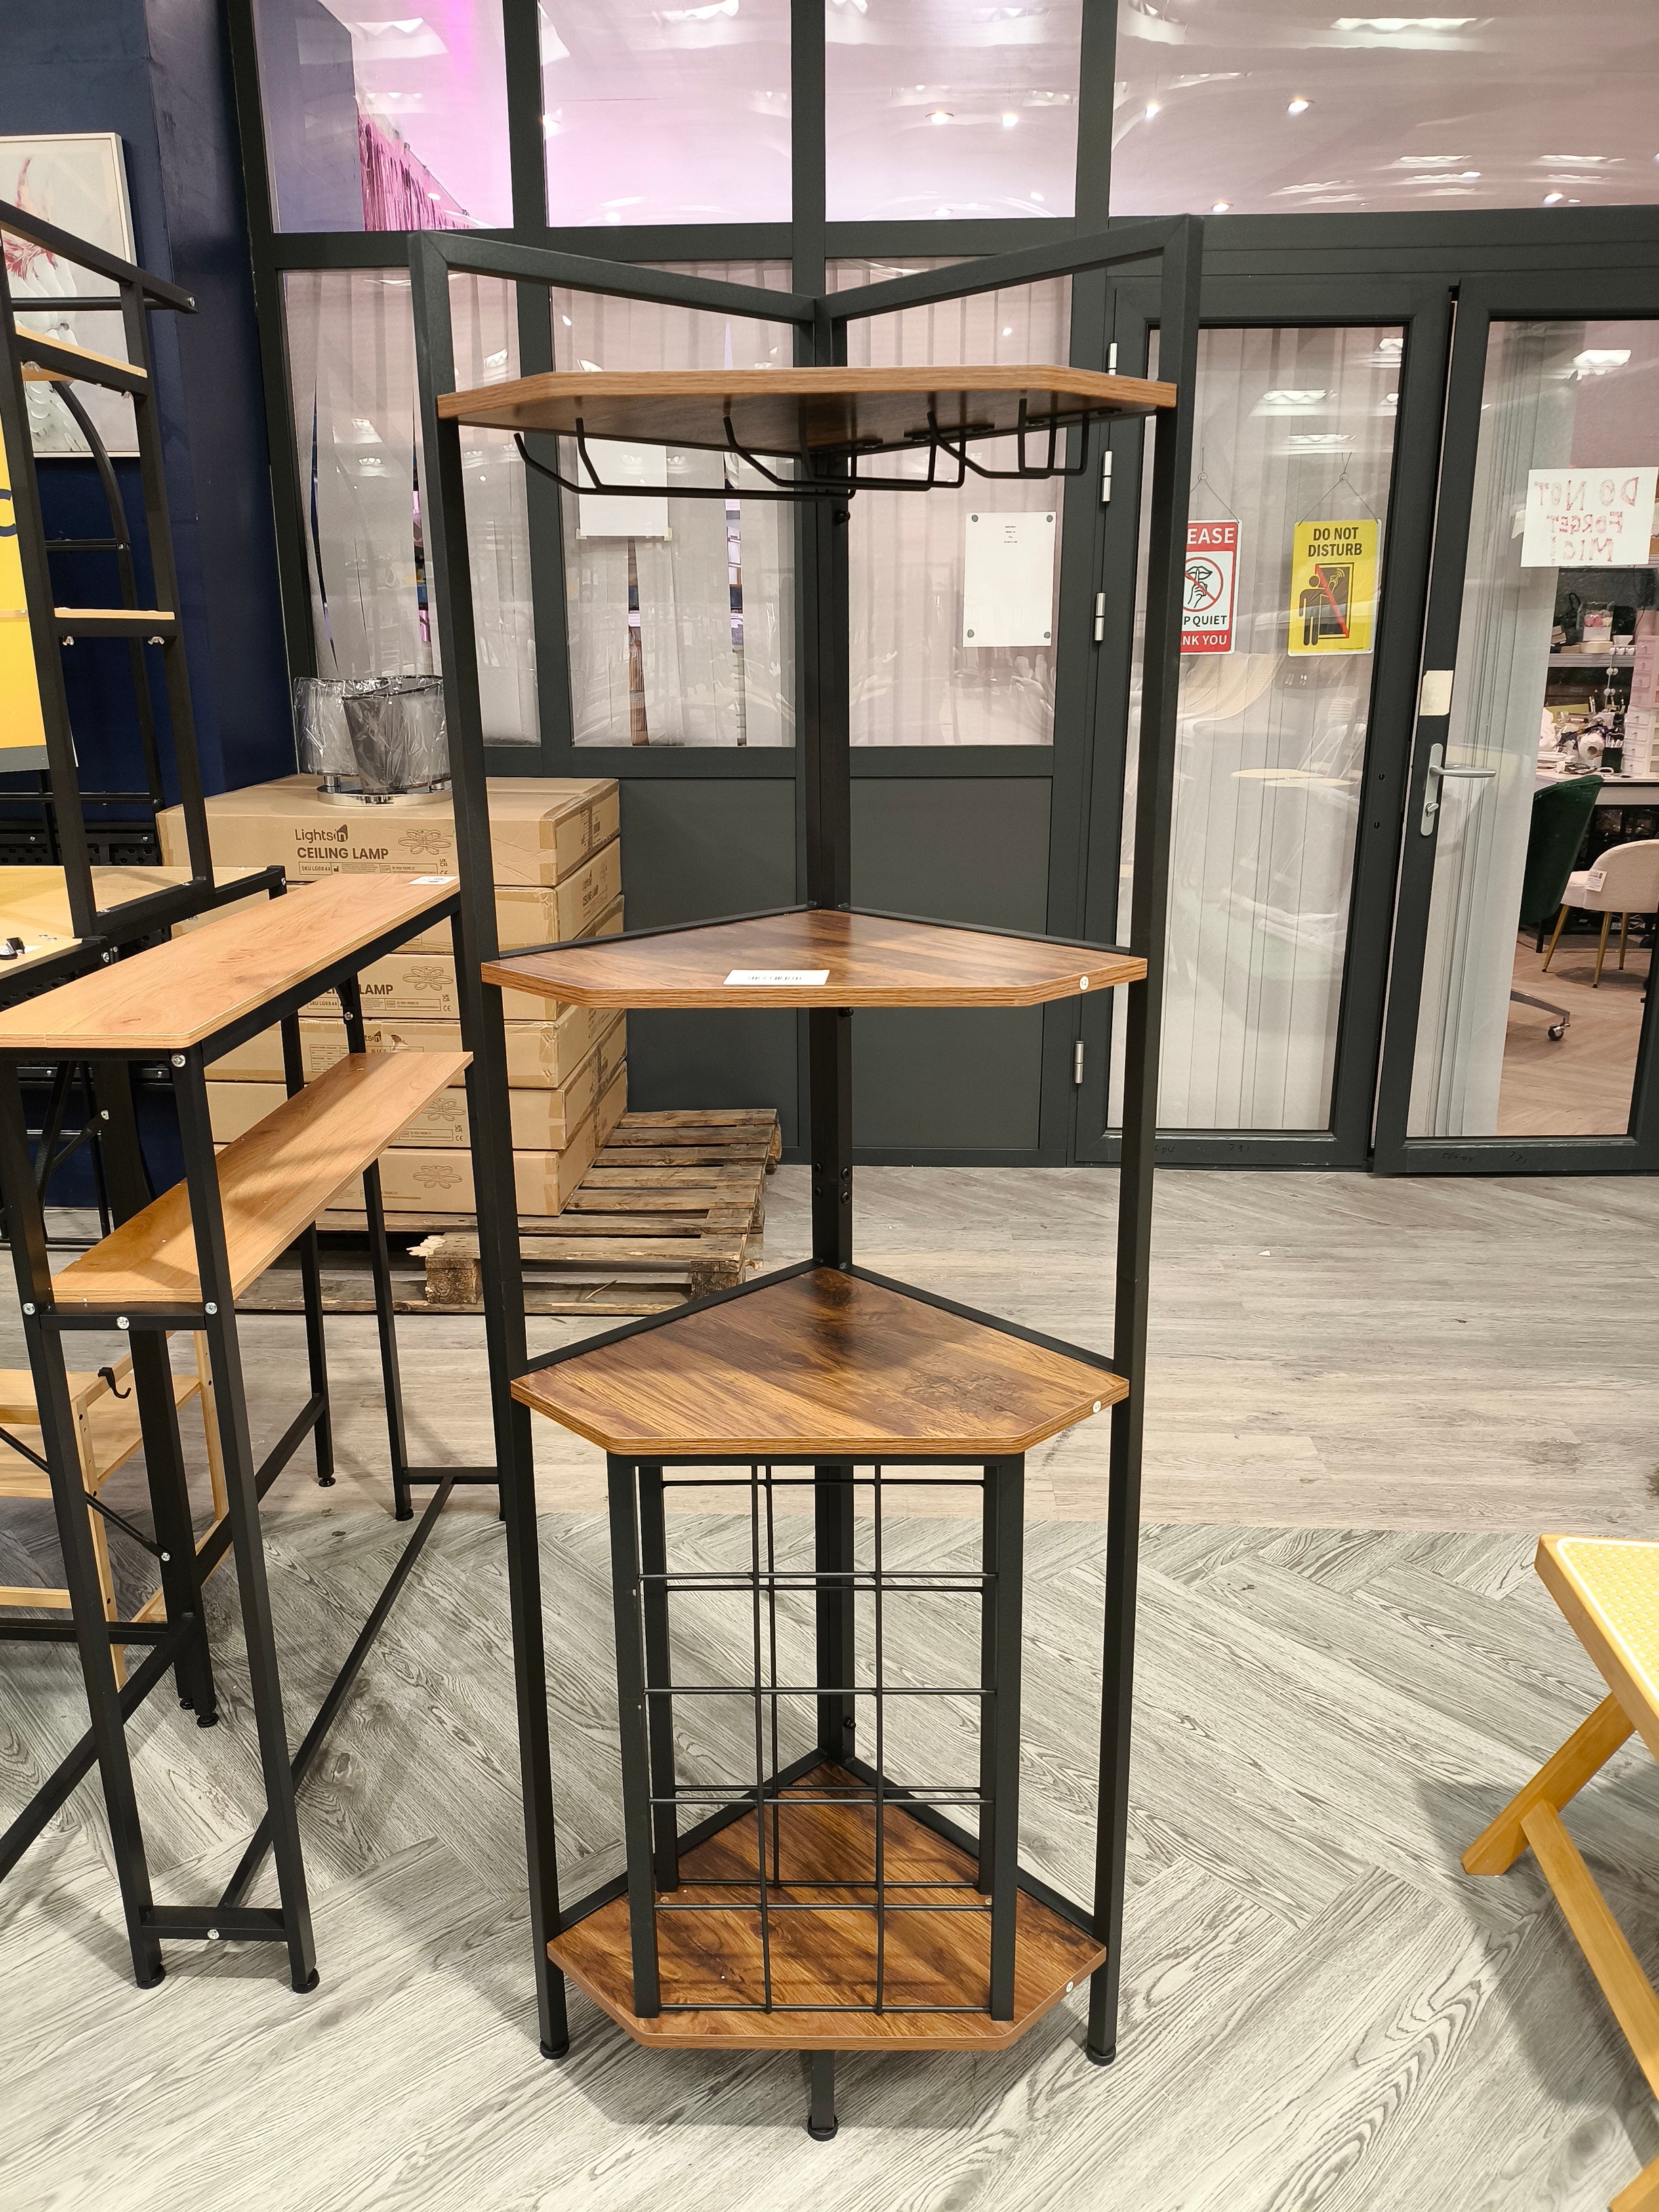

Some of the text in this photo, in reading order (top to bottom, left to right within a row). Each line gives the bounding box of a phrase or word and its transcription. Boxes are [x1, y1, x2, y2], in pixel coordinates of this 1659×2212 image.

[1187, 527, 1235, 545] EASE
[1313, 527, 1359, 541] DO NOT
[1308, 543, 1363, 557] DISTURB
[1192, 615, 1228, 628] QUIET
[1202, 634, 1227, 645] YOU
[297, 847, 389, 860] CEILING LAMP
[358, 984, 394, 995] LAMP
